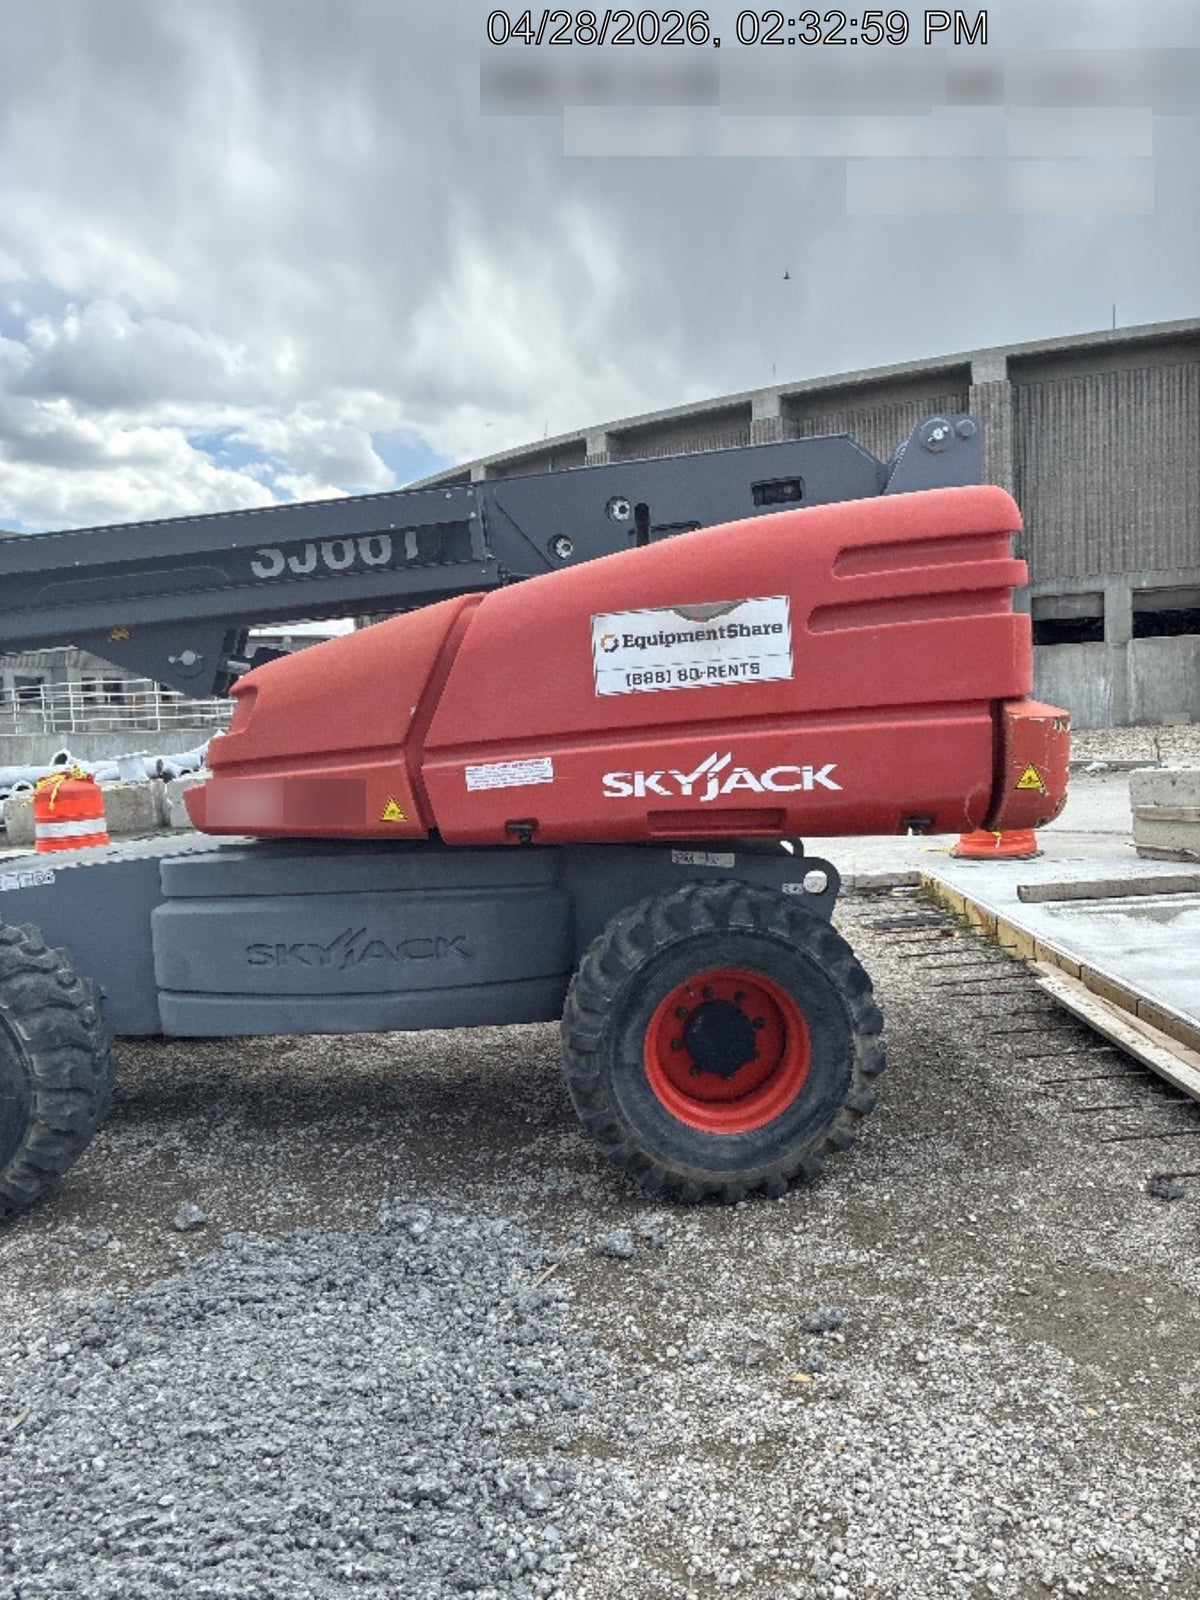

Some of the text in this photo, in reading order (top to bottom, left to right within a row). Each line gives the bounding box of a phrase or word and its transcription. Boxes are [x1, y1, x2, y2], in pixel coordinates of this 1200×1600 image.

[621, 622, 784, 650] EquipmentShare
[601, 751, 844, 802] SKYJACK
[245, 926, 473, 971] SKYJACK
